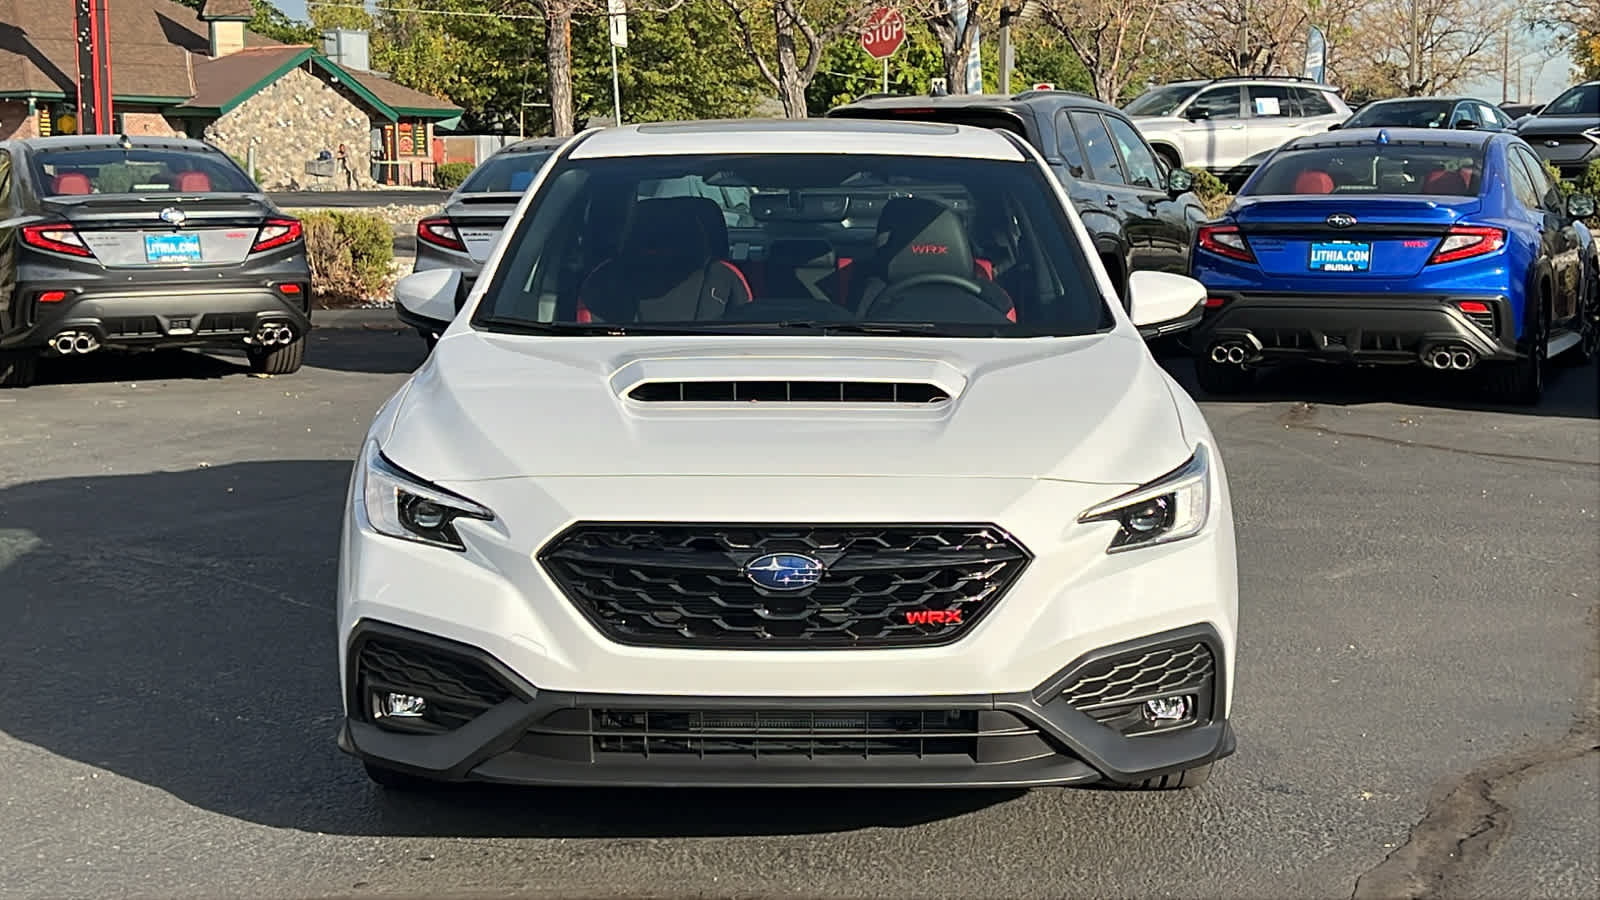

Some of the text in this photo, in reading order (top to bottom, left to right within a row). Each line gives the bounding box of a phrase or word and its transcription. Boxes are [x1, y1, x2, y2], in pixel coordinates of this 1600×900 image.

[864, 21, 902, 44] STOP
[912, 244, 949, 254] WRX
[1311, 250, 1369, 262] LITHIA.COM
[906, 609, 962, 625] WRX
